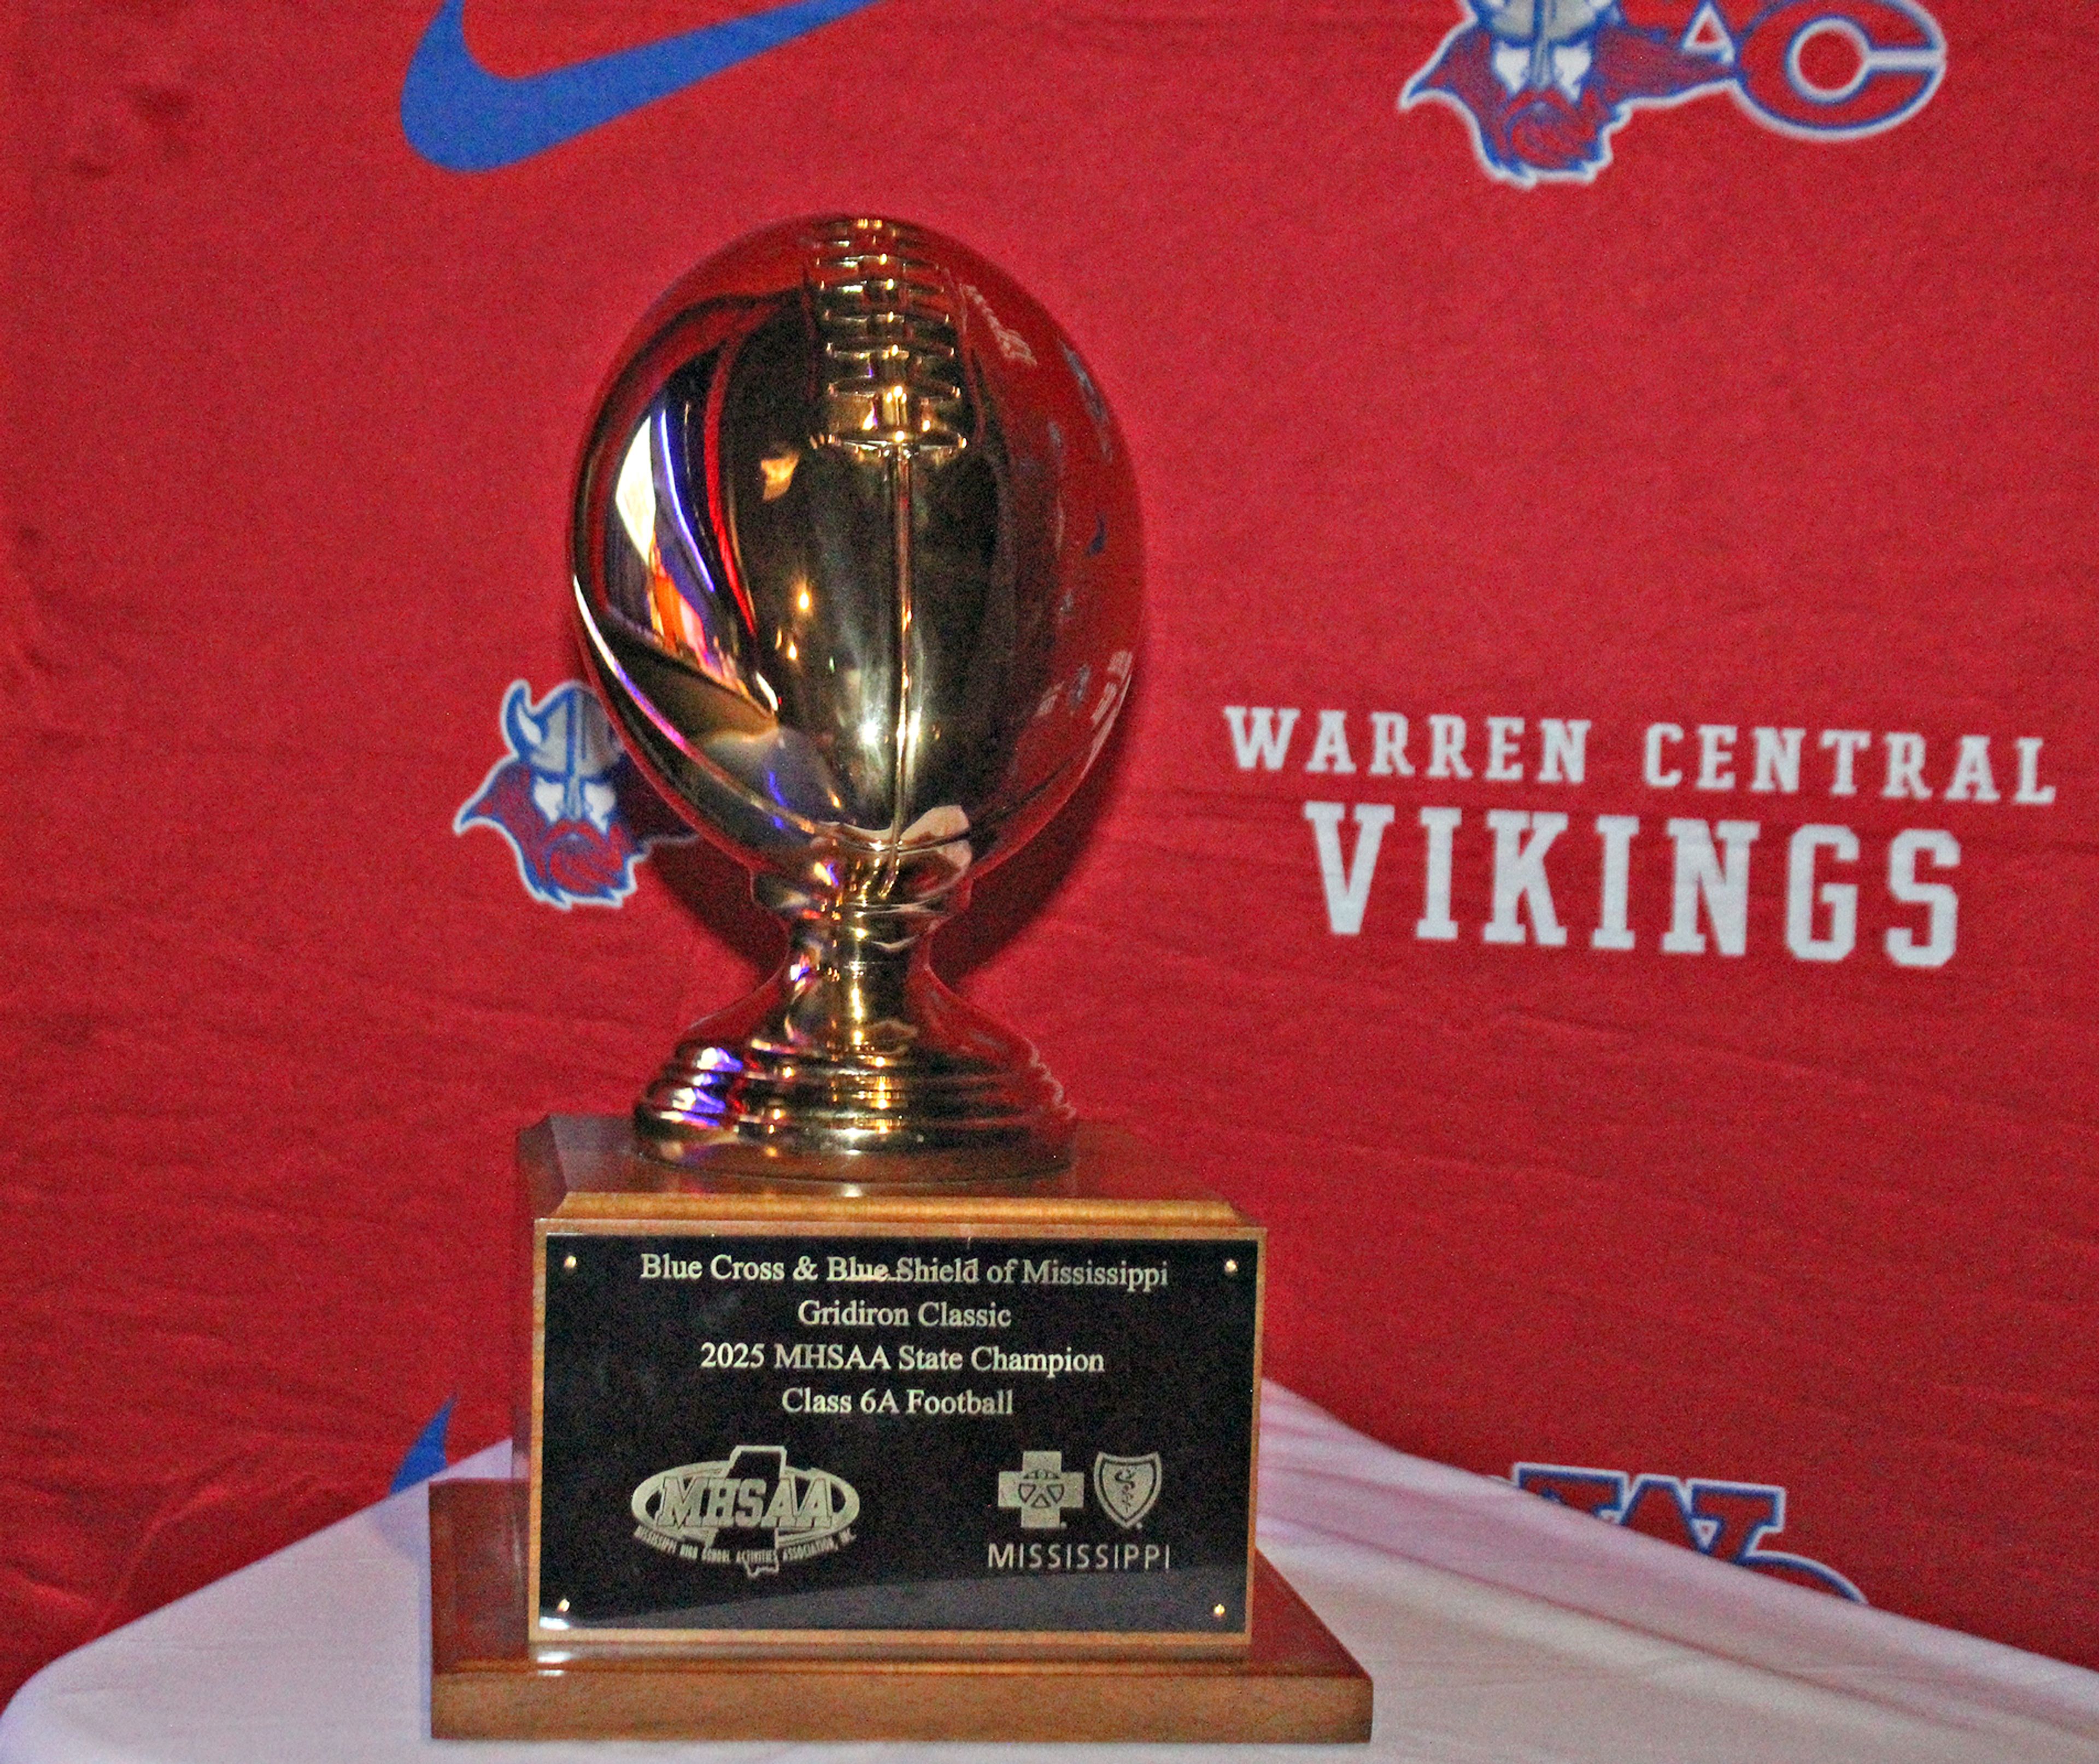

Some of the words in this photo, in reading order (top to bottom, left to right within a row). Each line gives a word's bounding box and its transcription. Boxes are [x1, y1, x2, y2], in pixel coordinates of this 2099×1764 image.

[1223, 705, 1592, 784] WARREN
[1643, 722, 2056, 805] CENTRAL
[1304, 801, 1962, 968] VIKINGS
[641, 1253, 702, 1279] Blue
[711, 1255, 784, 1281] Cross
[793, 1256, 818, 1281] &
[826, 1257, 889, 1282] Blue
[896, 1258, 978, 1282] Shield
[987, 1259, 1018, 1283] of
[1023, 1260, 1169, 1292] Mississippi
[798, 1300, 909, 1326] Gridiron
[918, 1302, 1011, 1327] Classic
[701, 1342, 764, 1368] 2025
[775, 1344, 891, 1370] MHSAA
[899, 1345, 963, 1370] State
[971, 1346, 1104, 1378] Champion
[782, 1387, 852, 1414] Class
[860, 1388, 899, 1414] 6A
[906, 1390, 1013, 1414] Football
[656, 1476, 833, 1528] MHSAA
[988, 1543, 1170, 1570] MISSISSIPPI
